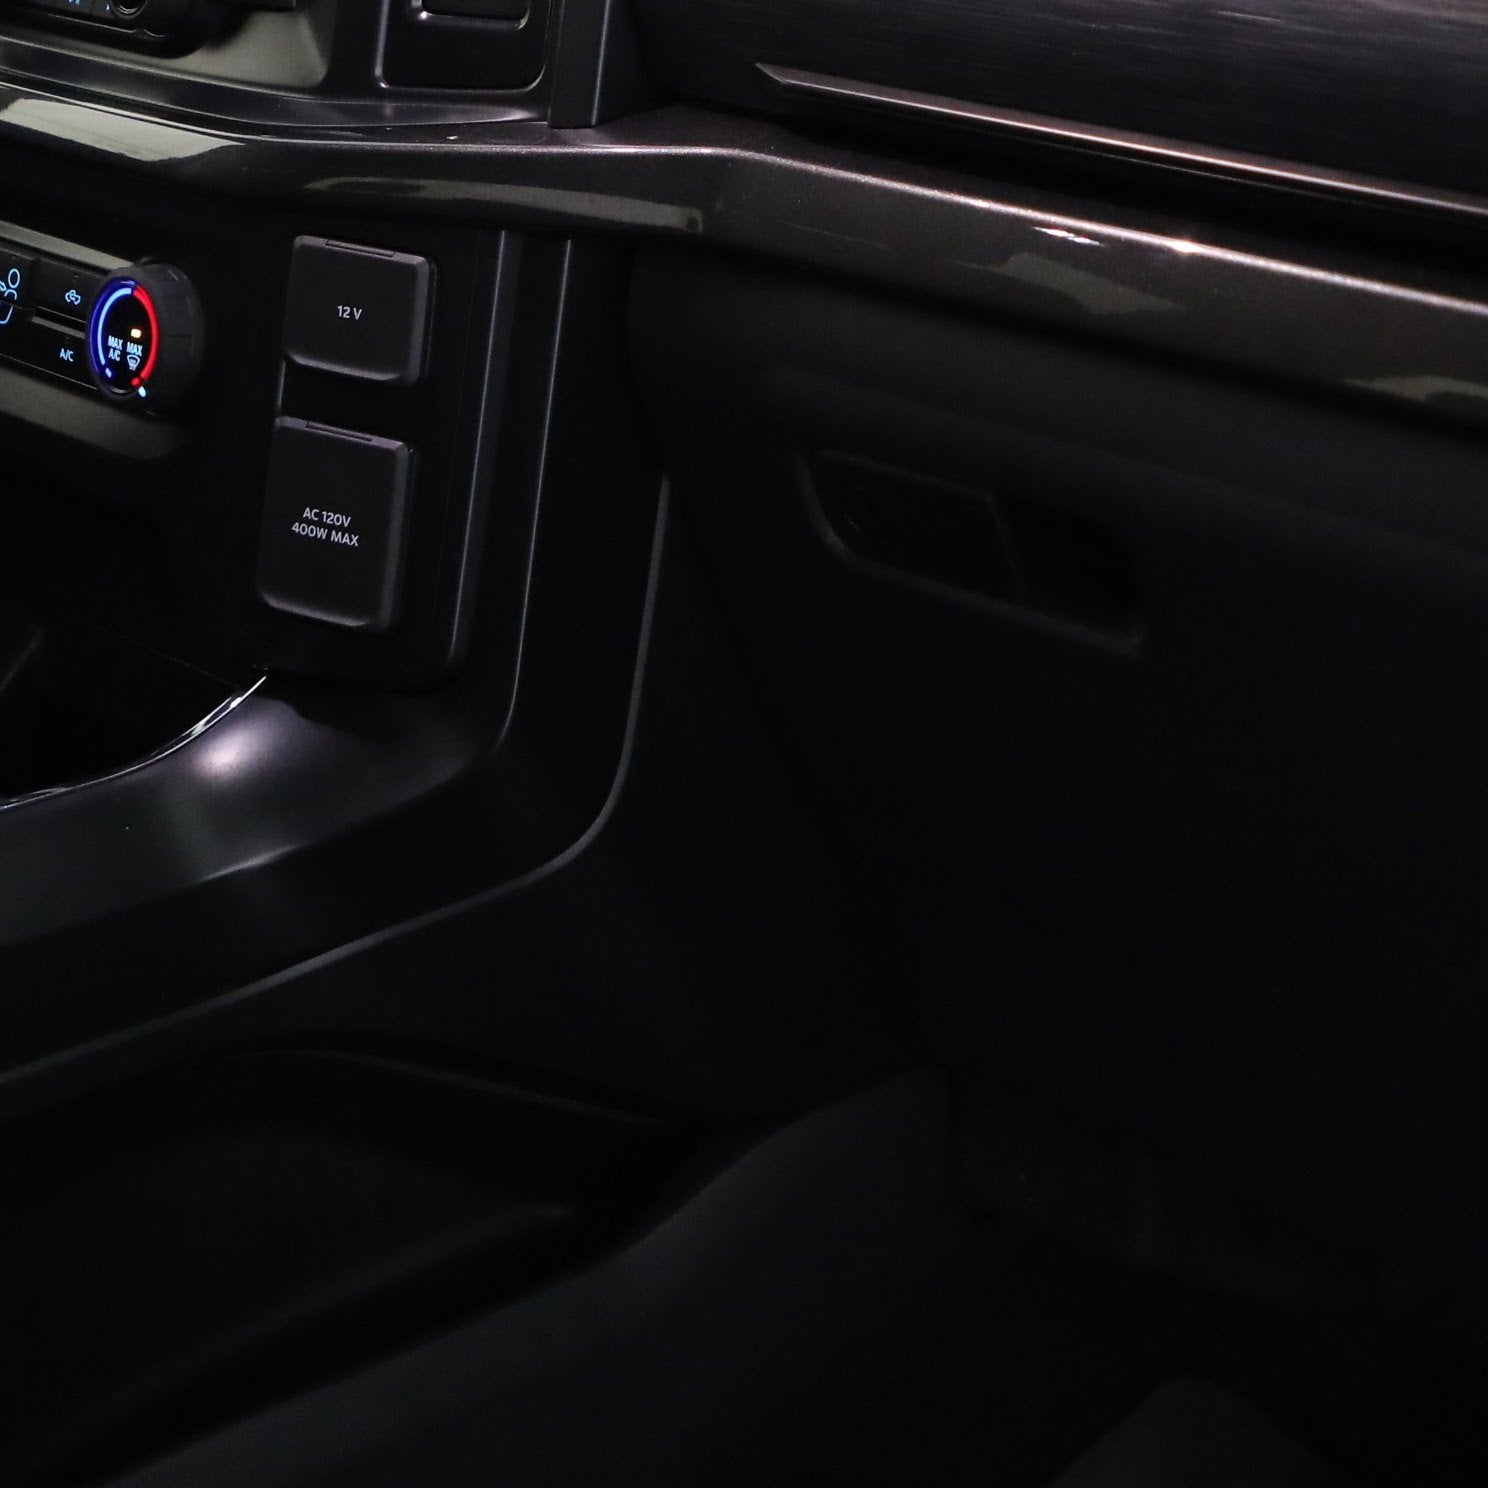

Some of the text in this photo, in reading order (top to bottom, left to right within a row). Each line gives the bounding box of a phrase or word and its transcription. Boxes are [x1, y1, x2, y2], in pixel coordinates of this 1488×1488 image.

[336, 304, 363, 321] 12 V
[107, 334, 124, 351] MAX
[126, 341, 143, 357] MAX
[59, 346, 75, 364] A/C
[107, 348, 122, 363] A/C
[302, 506, 352, 528] AC 120V
[291, 522, 360, 548] 400W MAX
